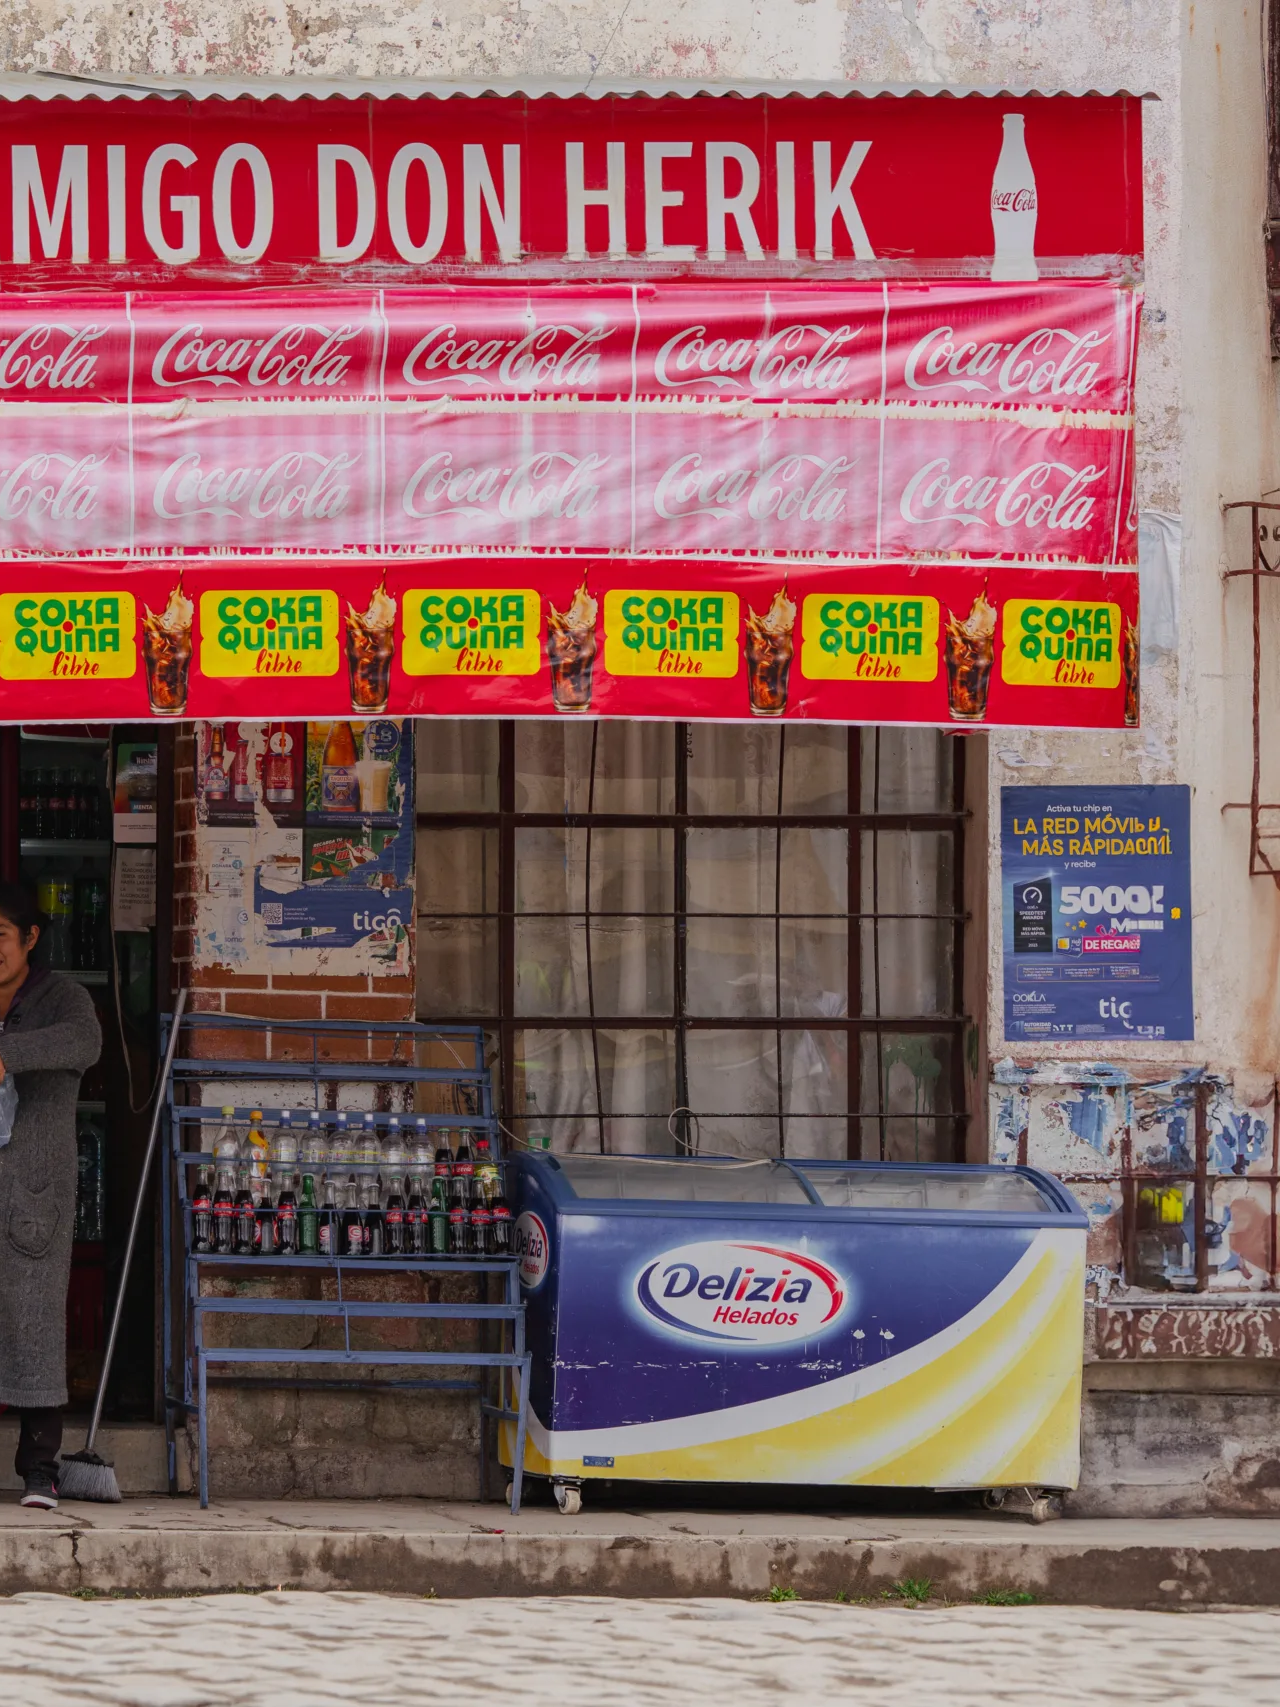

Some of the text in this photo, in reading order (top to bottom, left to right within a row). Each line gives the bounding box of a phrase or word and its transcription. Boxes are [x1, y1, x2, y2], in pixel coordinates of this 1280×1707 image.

[318, 142, 521, 265] DON
[565, 141, 879, 262] HERIK
[152, 323, 366, 389] Coca-Cola
[402, 324, 617, 388] Coca-Cola
[654, 324, 864, 389] Coca-Cola
[904, 326, 1112, 396] Coca-Cola
[152, 451, 362, 521] Coca-Cola
[402, 451, 611, 520] Coca-Cola
[654, 451, 861, 522] Coca-Cola
[899, 457, 1108, 531] Coca-Cola
[15, 597, 119, 628] COKA
[218, 595, 322, 625] COKA
[420, 594, 524, 624] COKA
[622, 596, 723, 625] COKA
[820, 600, 922, 629] COKA
[1020, 605, 1112, 636] COKA
[49, 652, 100, 677] libre
[253, 649, 303, 675] libre
[453, 646, 503, 672] libre
[655, 648, 703, 674] libre
[853, 652, 902, 678] libre
[1051, 657, 1096, 685] libre
[1046, 805, 1071, 813] Activa
[1083, 804, 1101, 814] chip
[1013, 818, 1079, 835] LA RED
[313, 840, 335, 848] RECARGA
[1022, 835, 1063, 856] MÁS
[1064, 860, 1096, 870] y recibe
[1085, 939, 1139, 950] DE REGA
[516, 1228, 543, 1258] Delizia
[663, 1263, 812, 1303] Delizia
[713, 1306, 799, 1326] Helados
